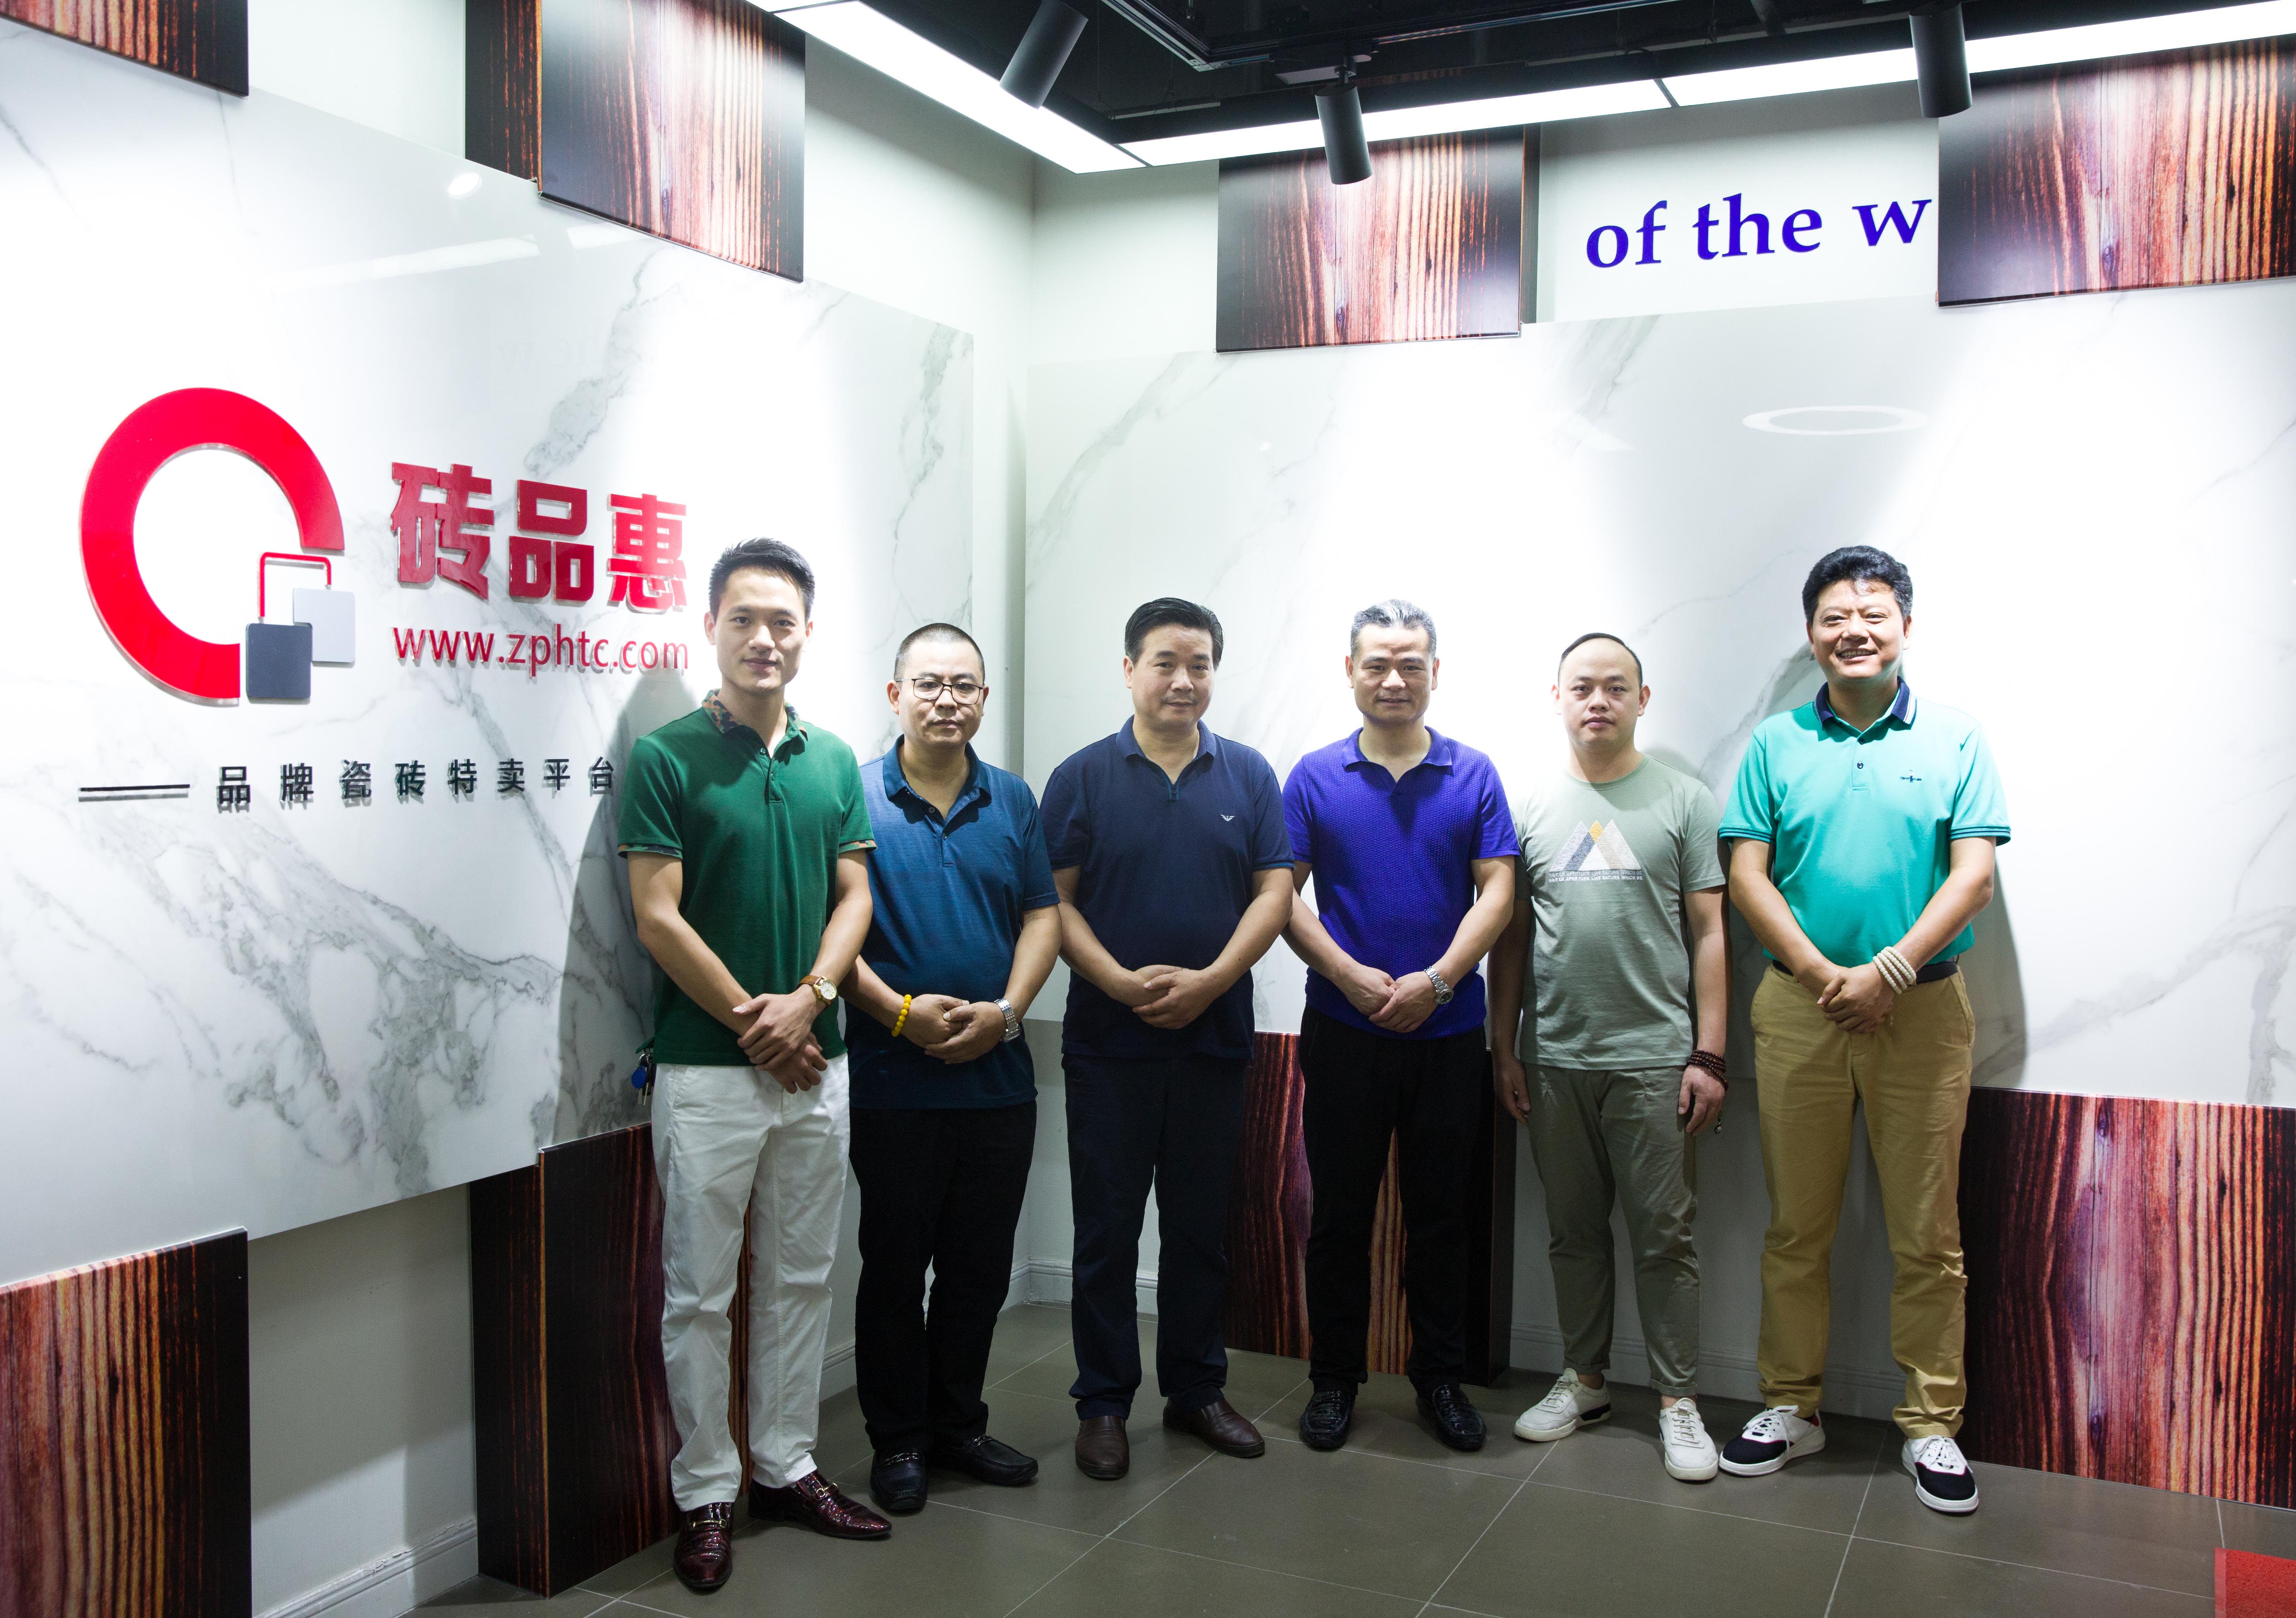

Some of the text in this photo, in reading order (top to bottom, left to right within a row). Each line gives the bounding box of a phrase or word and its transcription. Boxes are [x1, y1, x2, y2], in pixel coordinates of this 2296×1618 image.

[1586, 200, 1667, 268] of
[1692, 193, 1822, 260] the
[391, 462, 687, 610] 砖品惠
[391, 623, 688, 677] www.zphtc.com
[217, 756, 614, 805] 品牌瓷砖特卖平台
